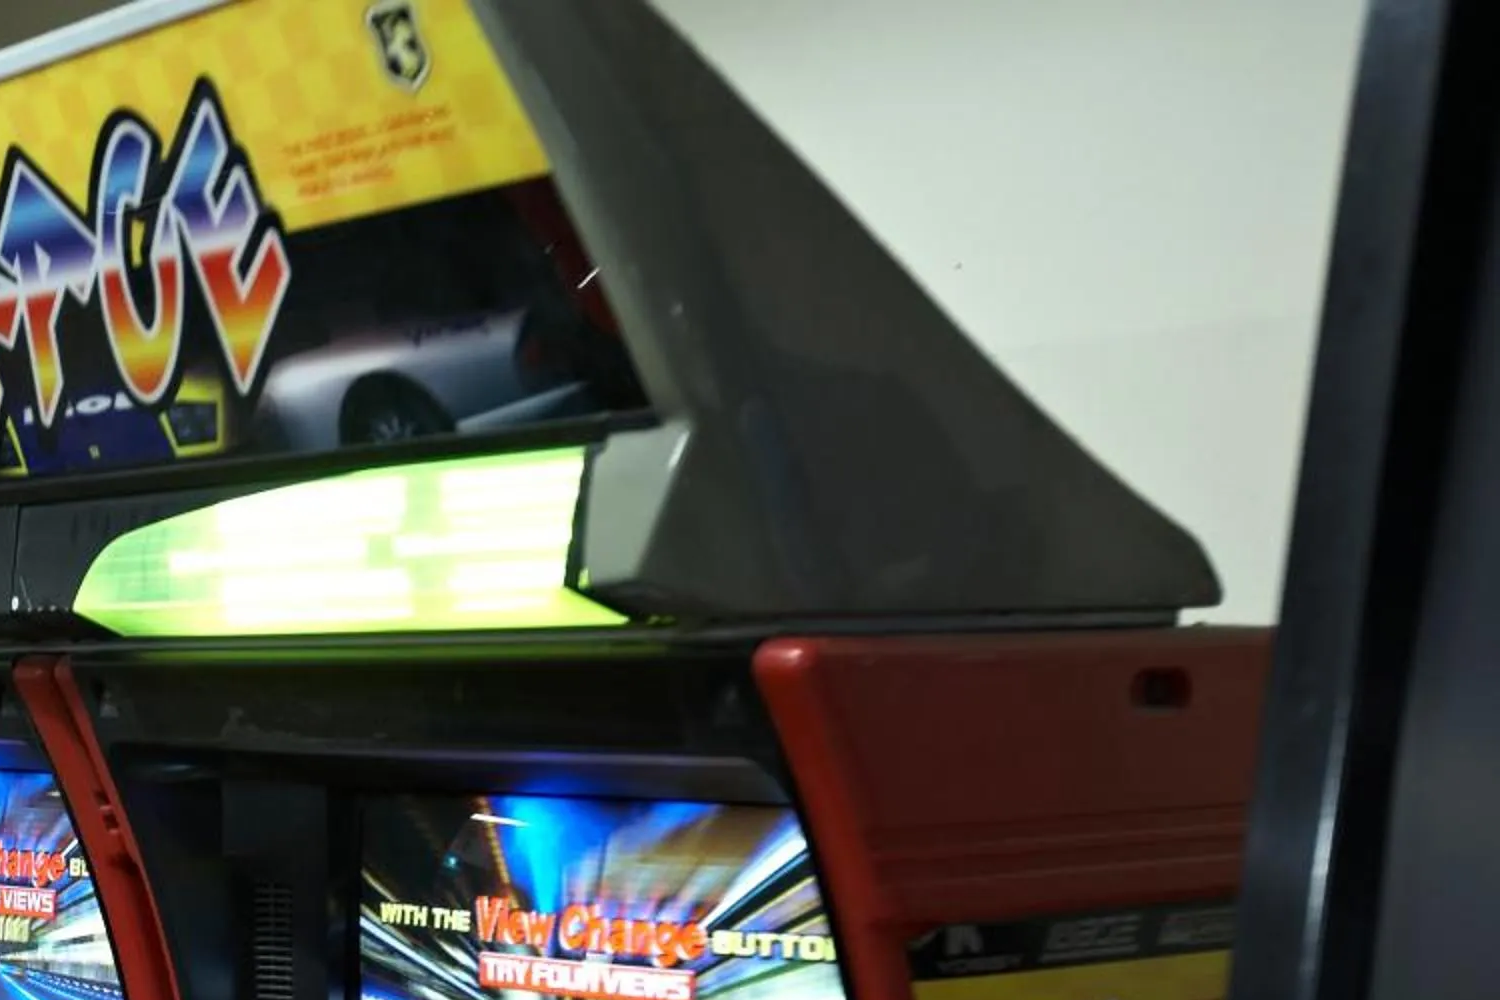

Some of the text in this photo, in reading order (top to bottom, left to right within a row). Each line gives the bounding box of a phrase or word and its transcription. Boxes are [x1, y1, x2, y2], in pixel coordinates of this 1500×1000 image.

[2, 889, 55, 914] VIEWS
[380, 902, 427, 927] WITH
[431, 905, 471, 933] THE
[475, 895, 555, 950] View
[558, 902, 708, 967] Change
[485, 958, 692, 1000] TRY FOUR VIEWS
